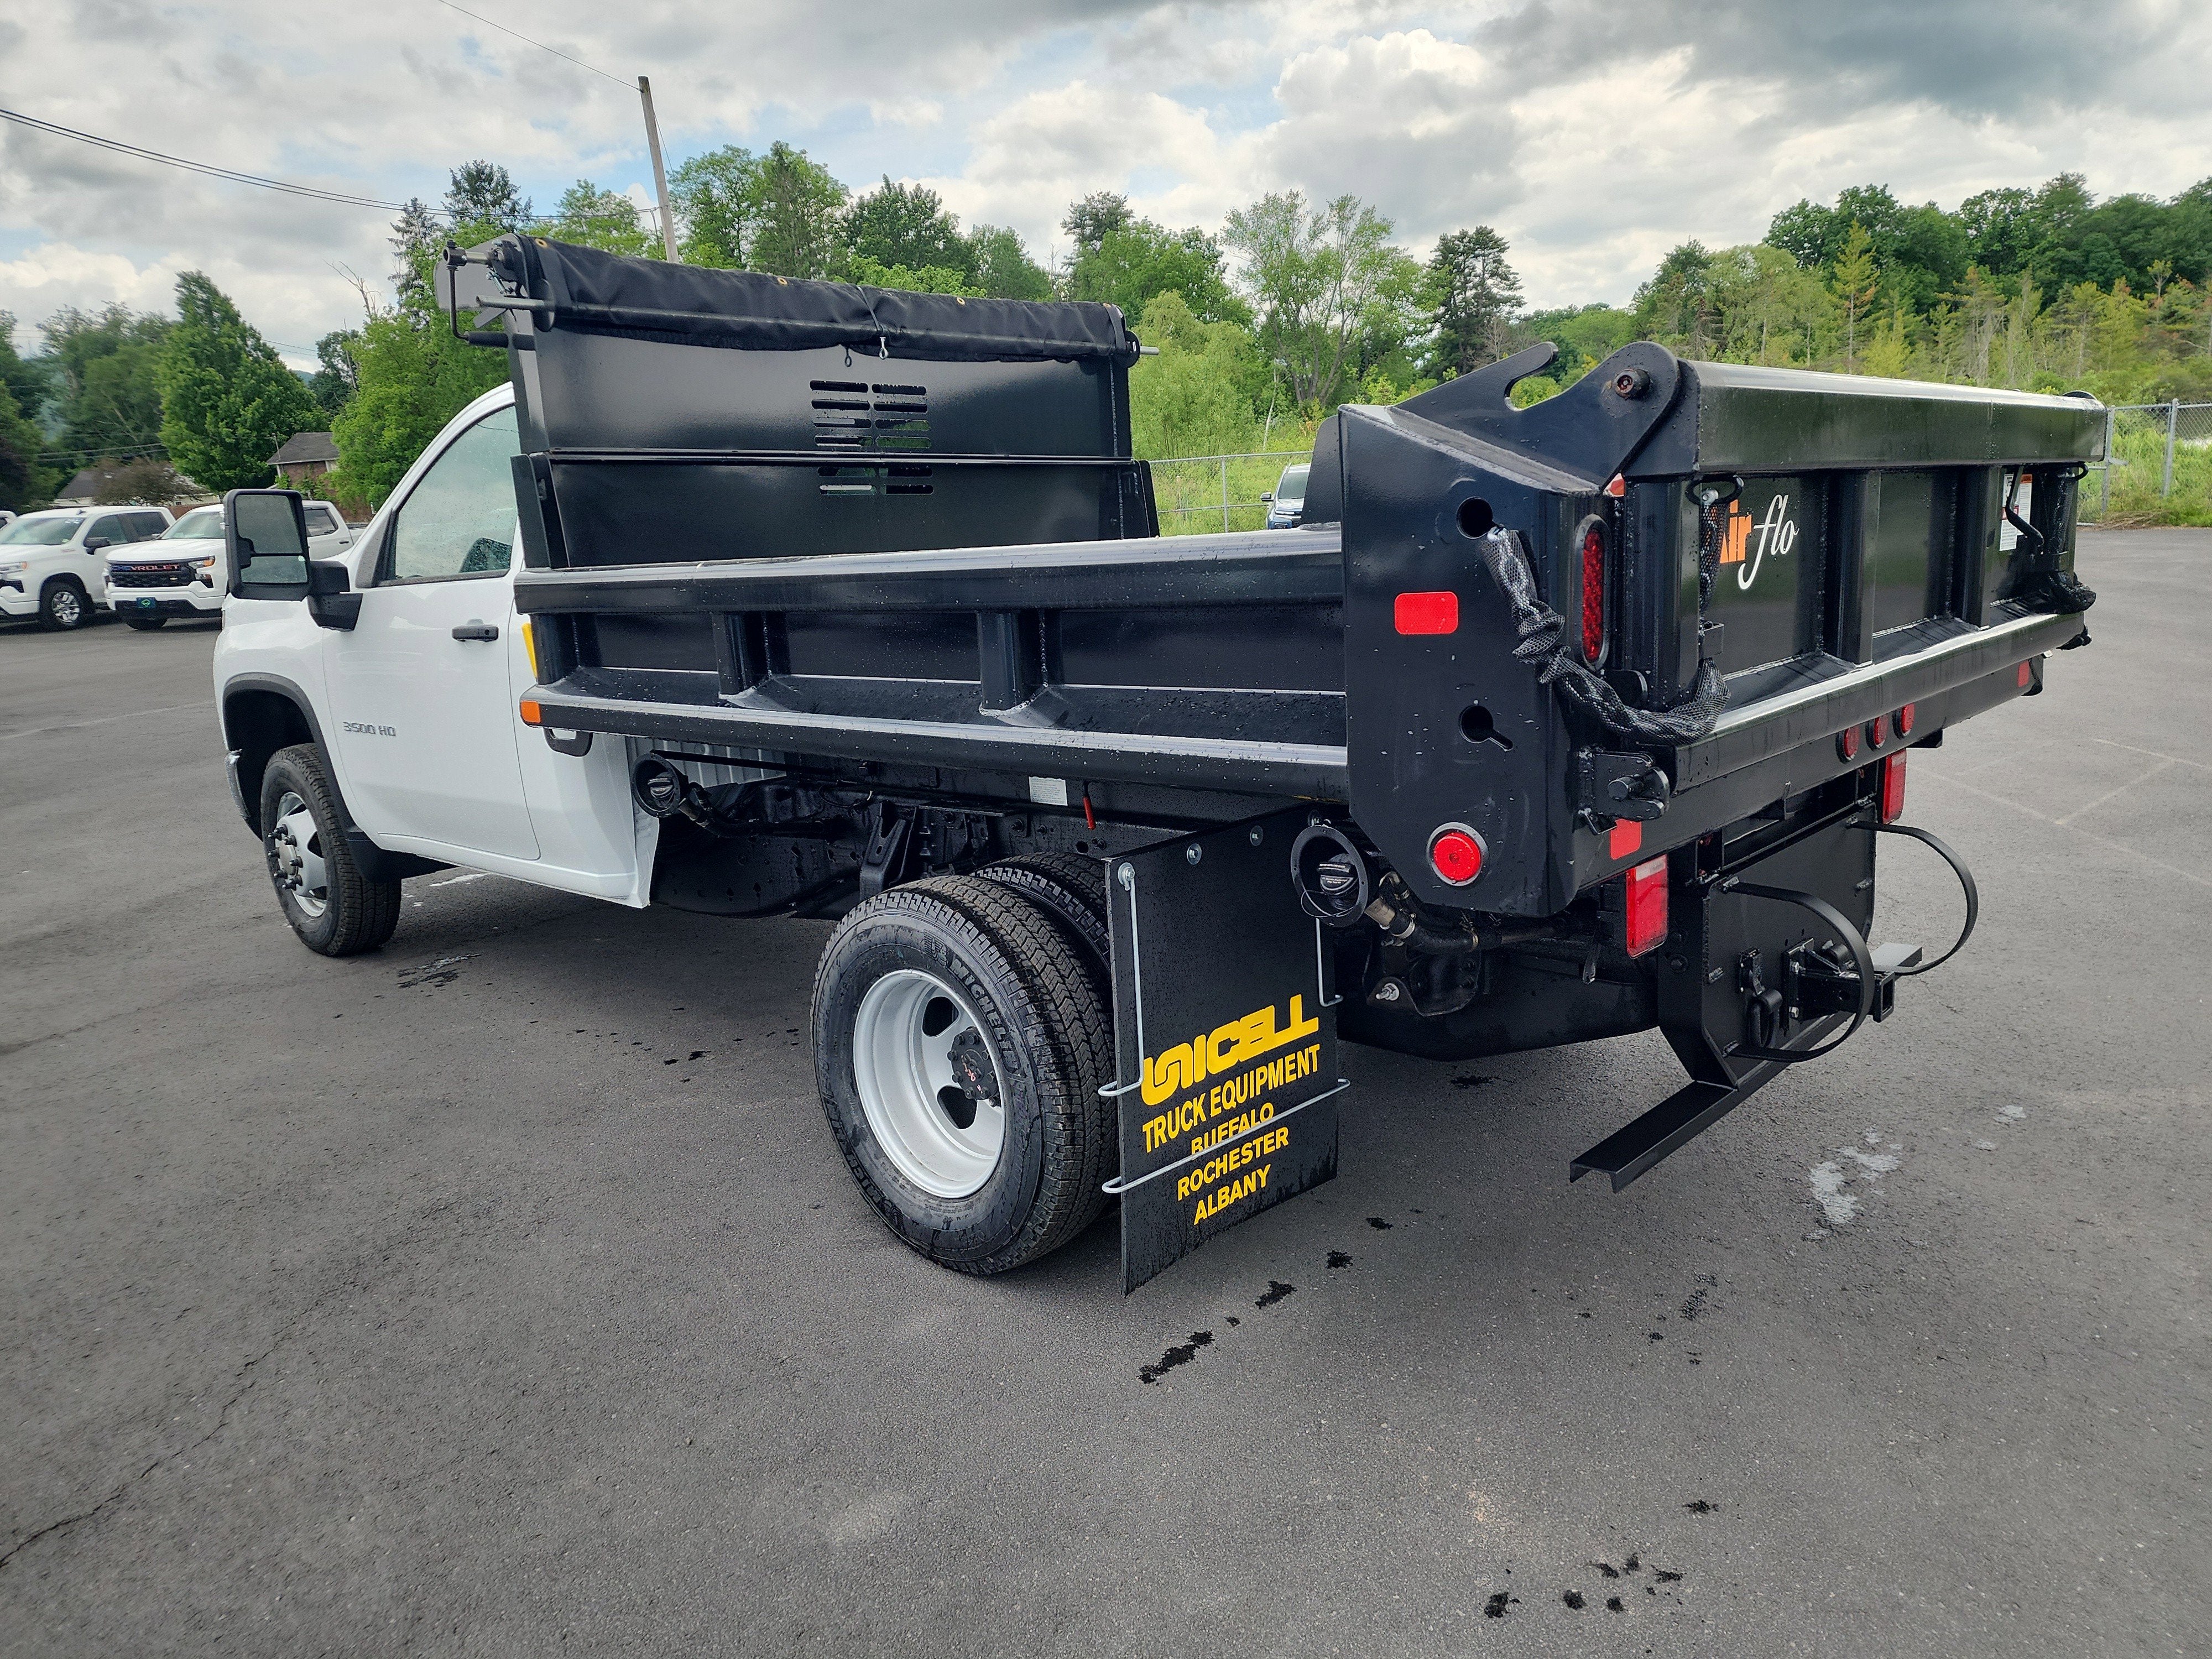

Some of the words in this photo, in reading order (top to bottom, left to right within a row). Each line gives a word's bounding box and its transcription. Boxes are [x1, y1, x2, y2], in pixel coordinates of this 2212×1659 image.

[343, 721, 376, 735] 3500
[378, 725, 397, 737] HD
[950, 958, 1019, 1070] MICHELIN
[1141, 994, 1319, 1106] UNICELL
[1142, 1093, 1207, 1153] TRUCK
[1210, 1043, 1321, 1118] EQUIPMENT
[1191, 1102, 1275, 1159] BUFFALO
[1177, 1126, 1289, 1201] ROCHESTER
[1194, 1164, 1271, 1225] ALBANY
